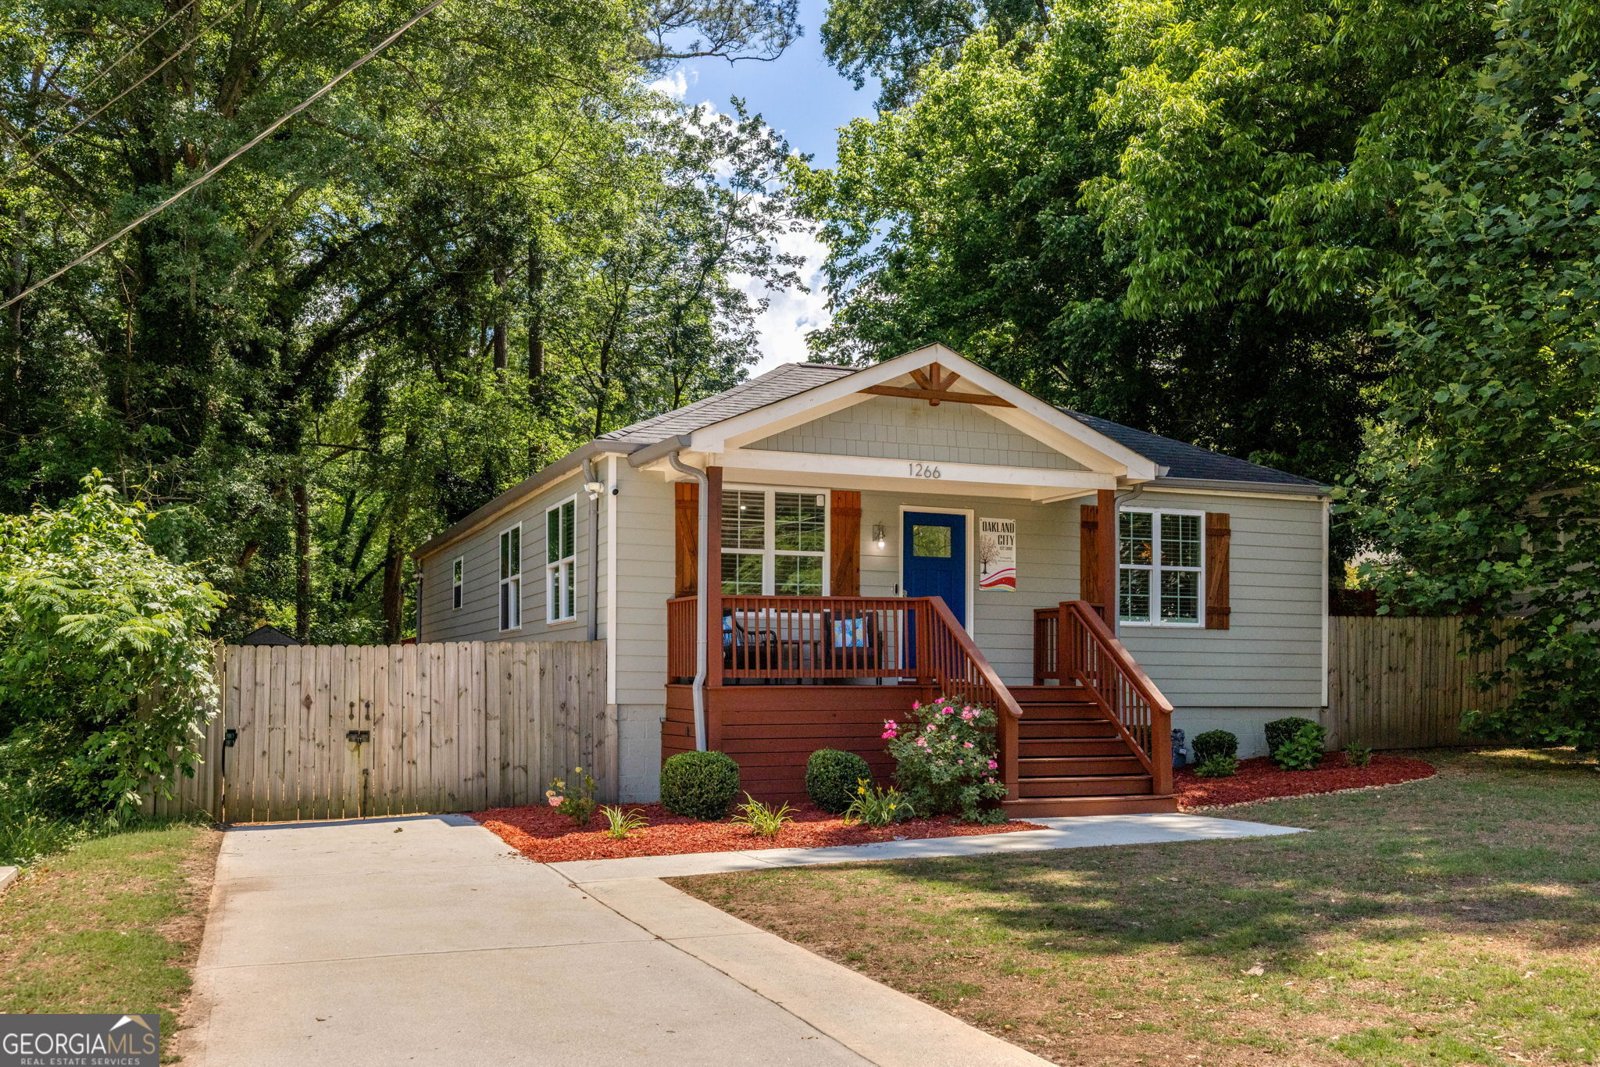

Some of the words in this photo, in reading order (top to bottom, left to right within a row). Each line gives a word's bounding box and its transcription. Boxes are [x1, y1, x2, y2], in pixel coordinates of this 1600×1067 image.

[909, 463, 941, 479] 1266
[982, 521, 1015, 533] OAKLAND
[997, 535, 1015, 546] CITY
